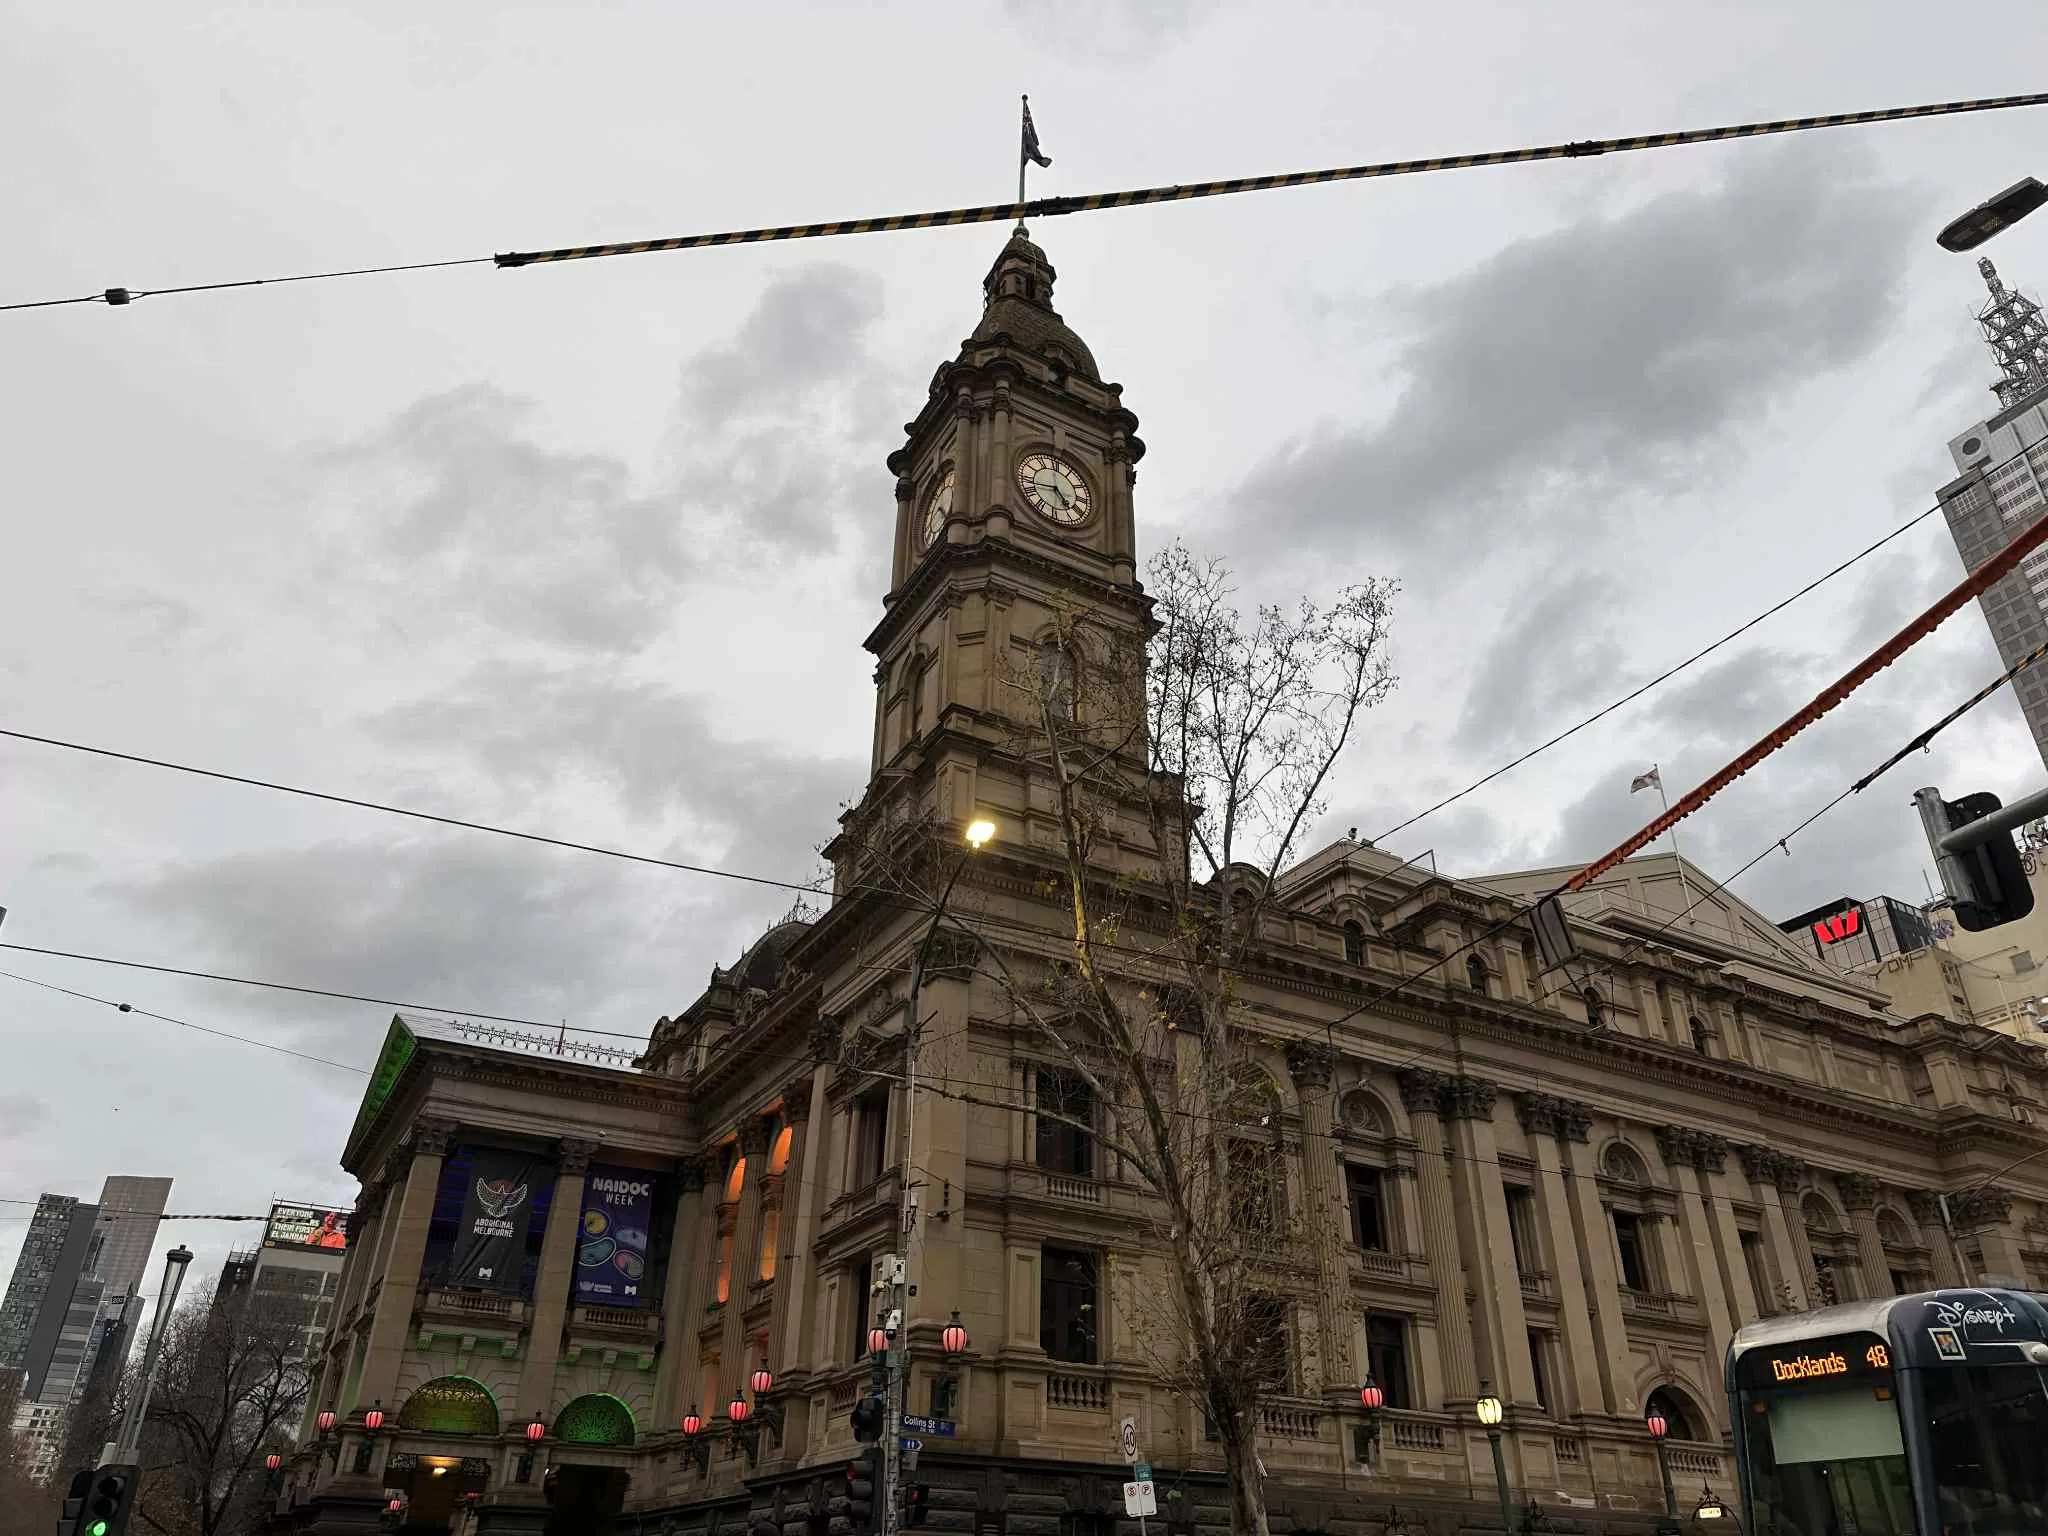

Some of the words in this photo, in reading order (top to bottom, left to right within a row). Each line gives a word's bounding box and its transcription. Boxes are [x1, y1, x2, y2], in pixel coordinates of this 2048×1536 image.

[592, 1176, 650, 1197] NAIDOC
[605, 1193, 635, 1207] WEEK
[277, 1207, 314, 1218] EVERYONE
[273, 1222, 295, 1232] THEIR
[295, 1225, 316, 1234] FIRST
[474, 1217, 515, 1230] ABORIGINAL
[473, 1226, 515, 1238] MELBOURNE
[1772, 1351, 1848, 1382] Docklands
[1866, 1343, 1889, 1368] 48
[904, 1415, 927, 1427] Collins
[928, 1419, 936, 1429] St
[1124, 1431, 1134, 1449] 40
